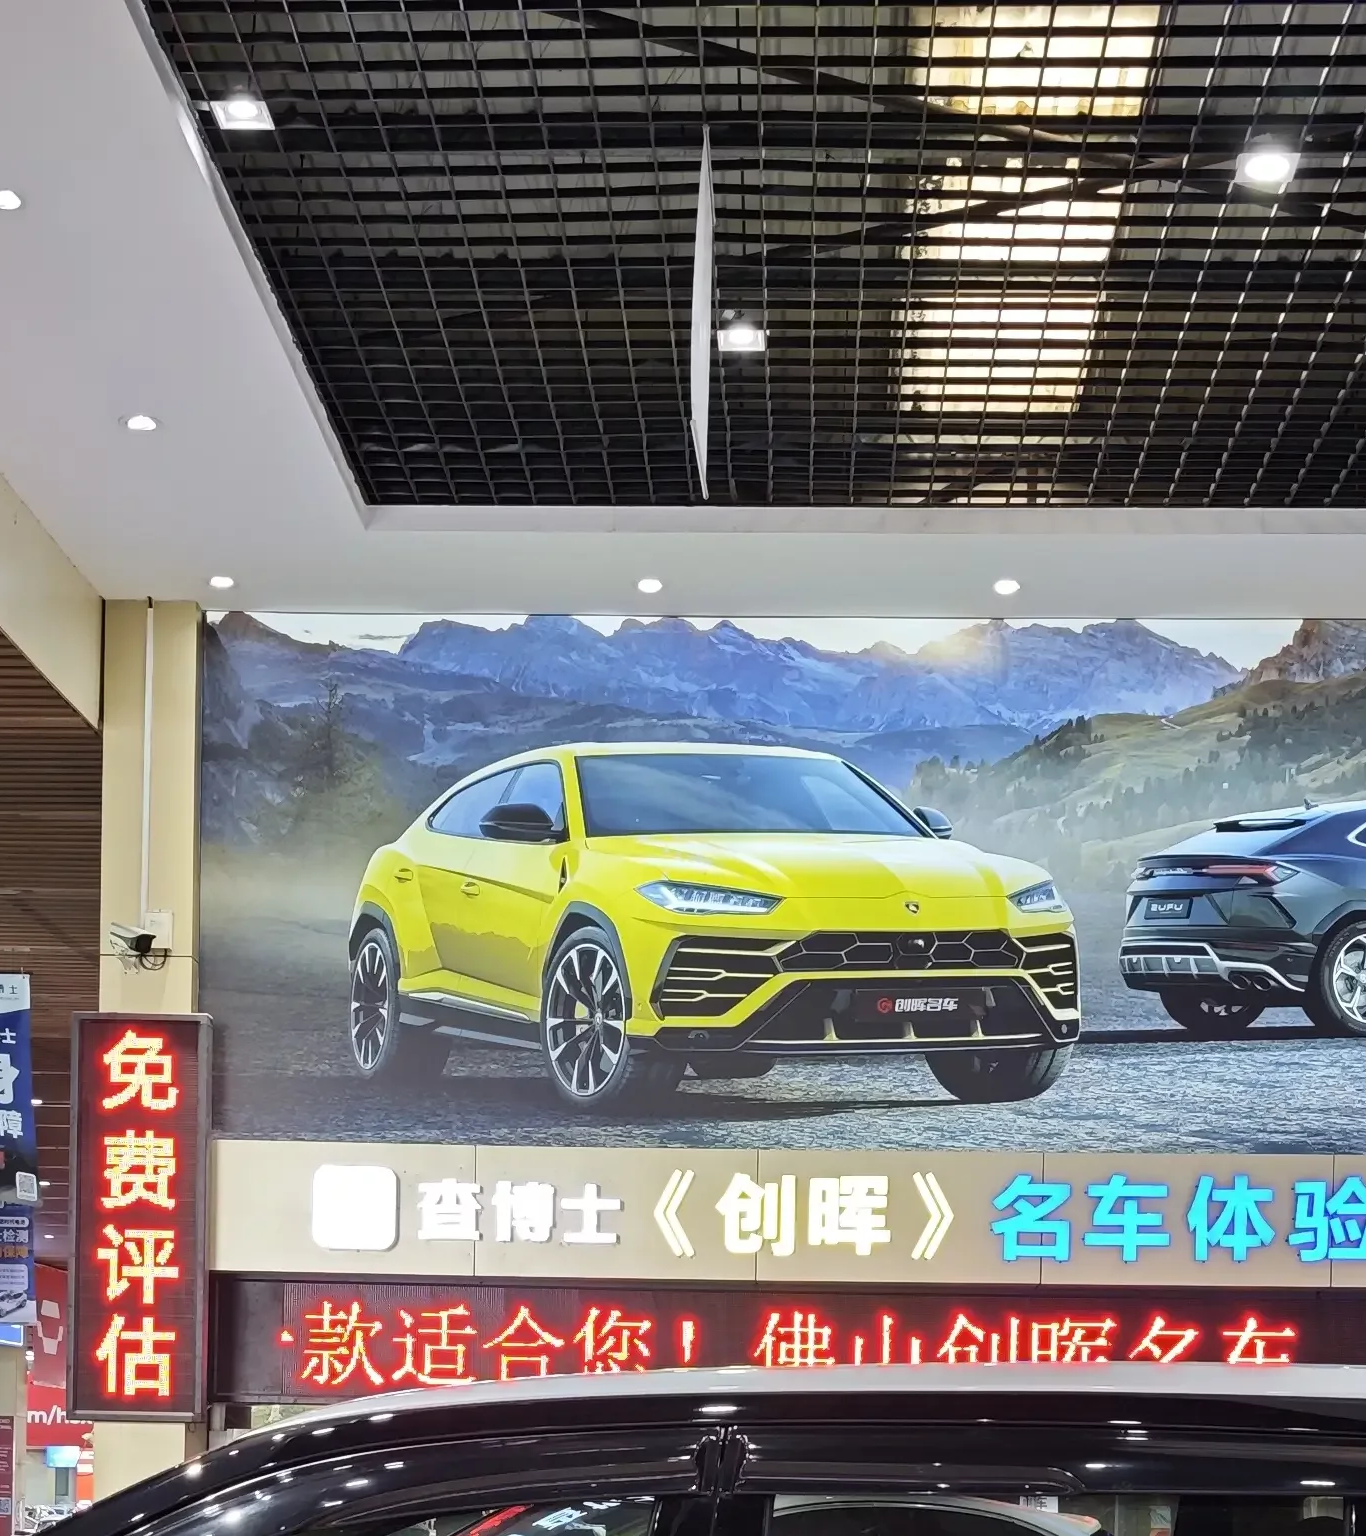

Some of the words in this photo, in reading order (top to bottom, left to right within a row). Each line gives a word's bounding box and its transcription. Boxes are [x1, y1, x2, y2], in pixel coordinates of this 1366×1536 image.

[895, 997, 960, 1013] 创晖名车
[96, 1030, 180, 1396] 免费评估
[416, 1179, 624, 1246] 查博士
[653, 1168, 955, 1261] 《创晖》
